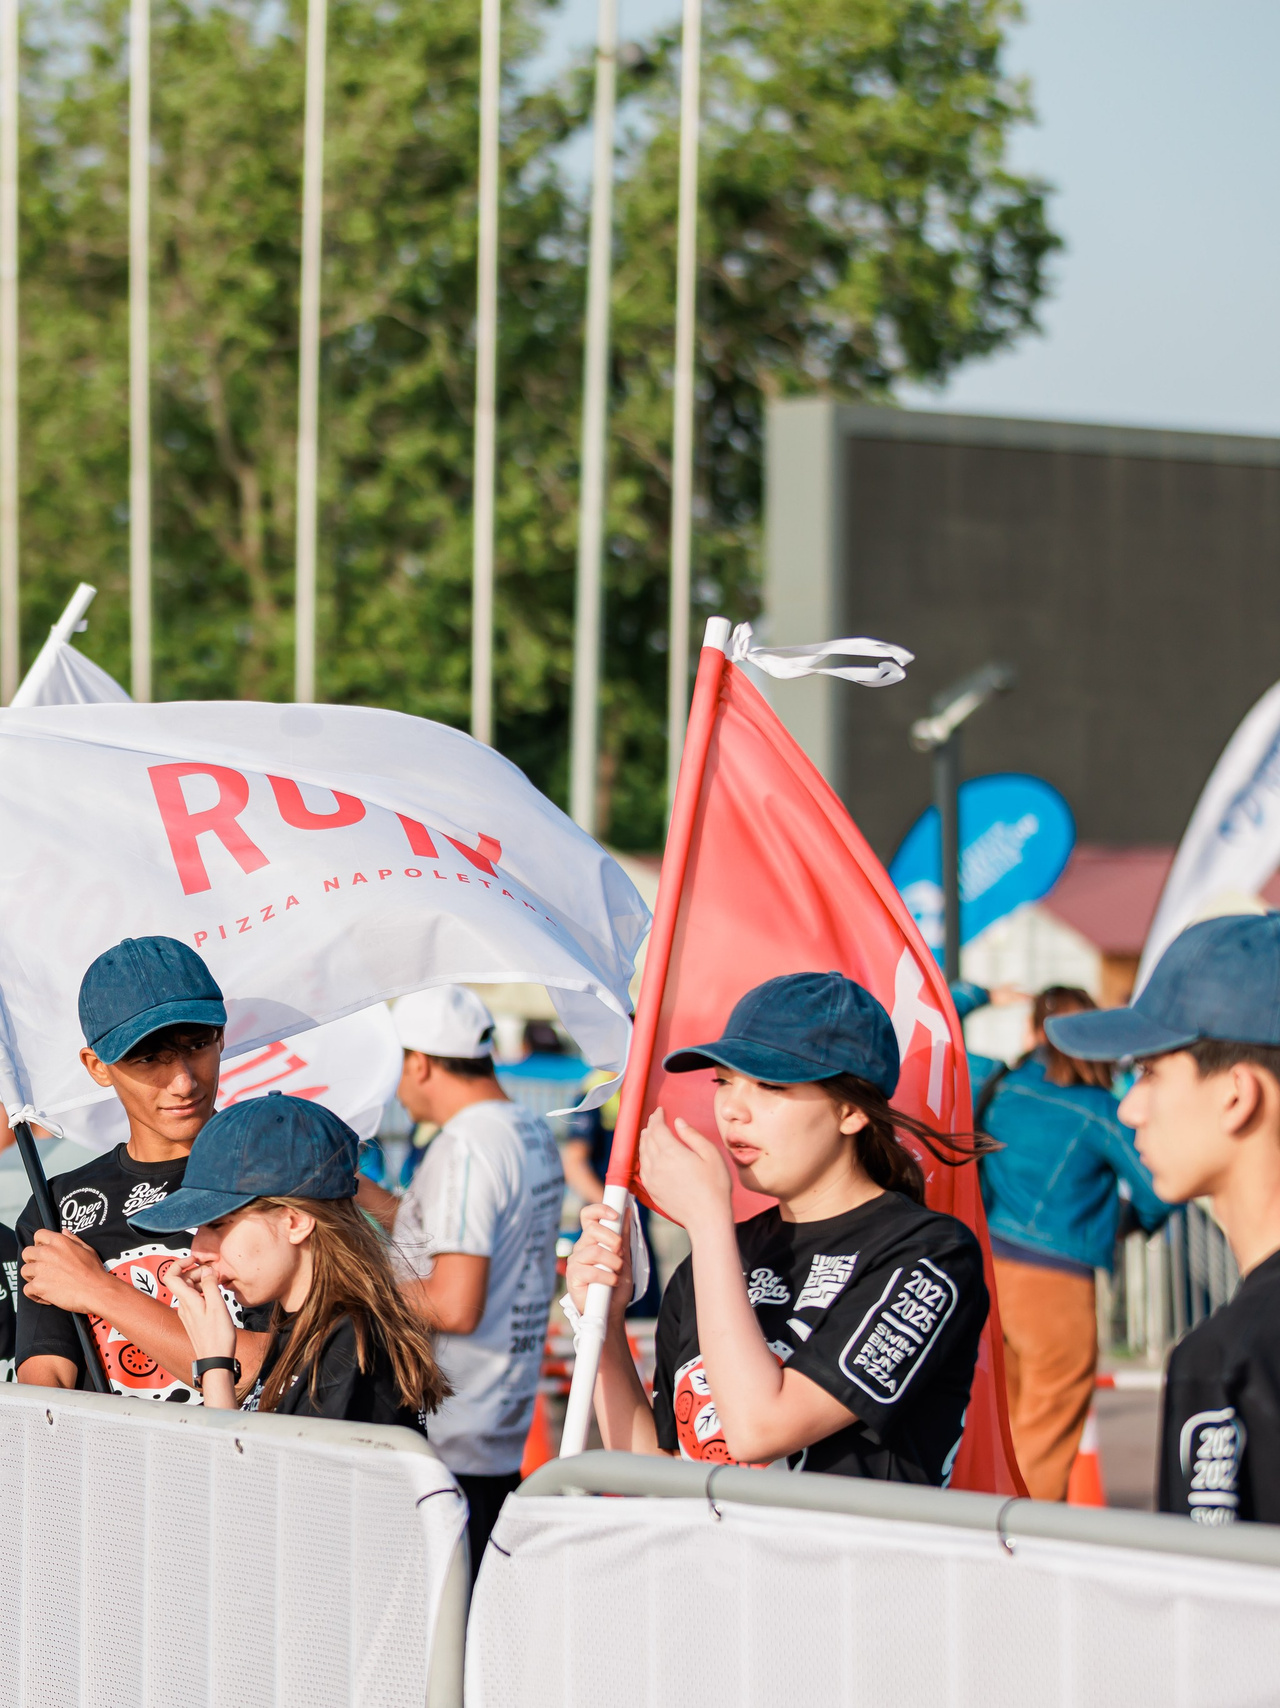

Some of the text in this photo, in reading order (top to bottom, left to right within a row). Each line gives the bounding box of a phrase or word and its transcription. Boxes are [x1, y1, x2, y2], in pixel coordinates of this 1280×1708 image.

[193, 893, 300, 948] PIZZA
[62, 1199, 102, 1221] Open
[903, 1270, 948, 1312] 2021
[891, 1291, 938, 1333] 2025
[860, 1342, 897, 1373] RUN
[867, 1332, 906, 1364] BIKE
[874, 1322, 917, 1357] SWIM
[852, 1353, 897, 1394] PIZZA
